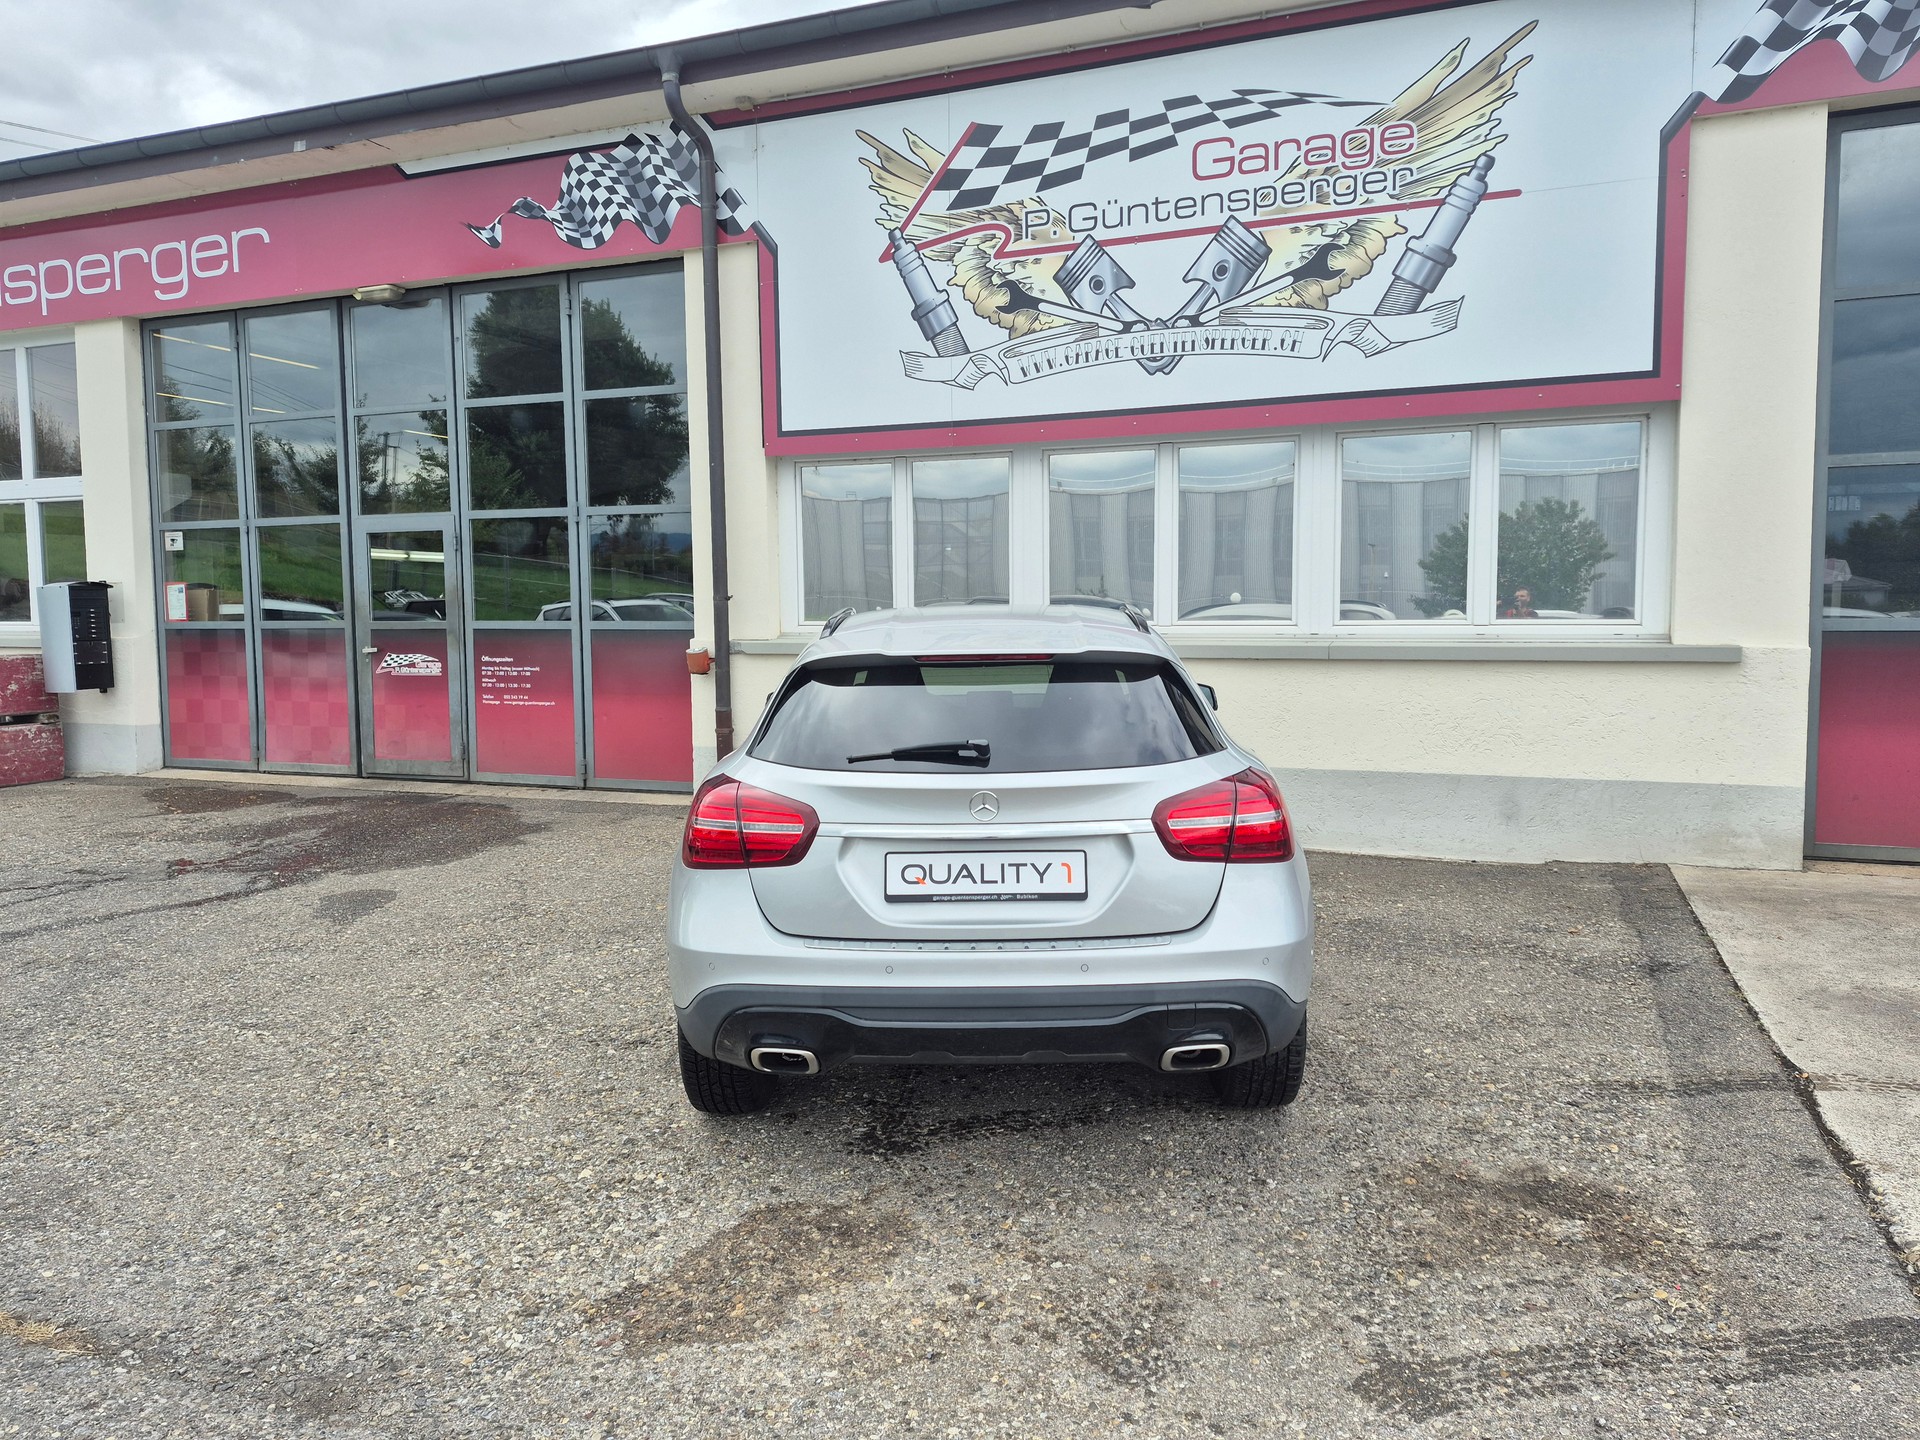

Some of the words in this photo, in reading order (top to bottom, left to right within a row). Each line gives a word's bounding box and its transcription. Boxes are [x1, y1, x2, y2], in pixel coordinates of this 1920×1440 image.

[1191, 121, 1416, 181] Garage
[1022, 209, 1059, 241] P.
[1065, 163, 1415, 234] Güntensperger
[0, 227, 270, 316] sperger
[900, 862, 1053, 885] QUALITY
[1060, 861, 1073, 884] 1
